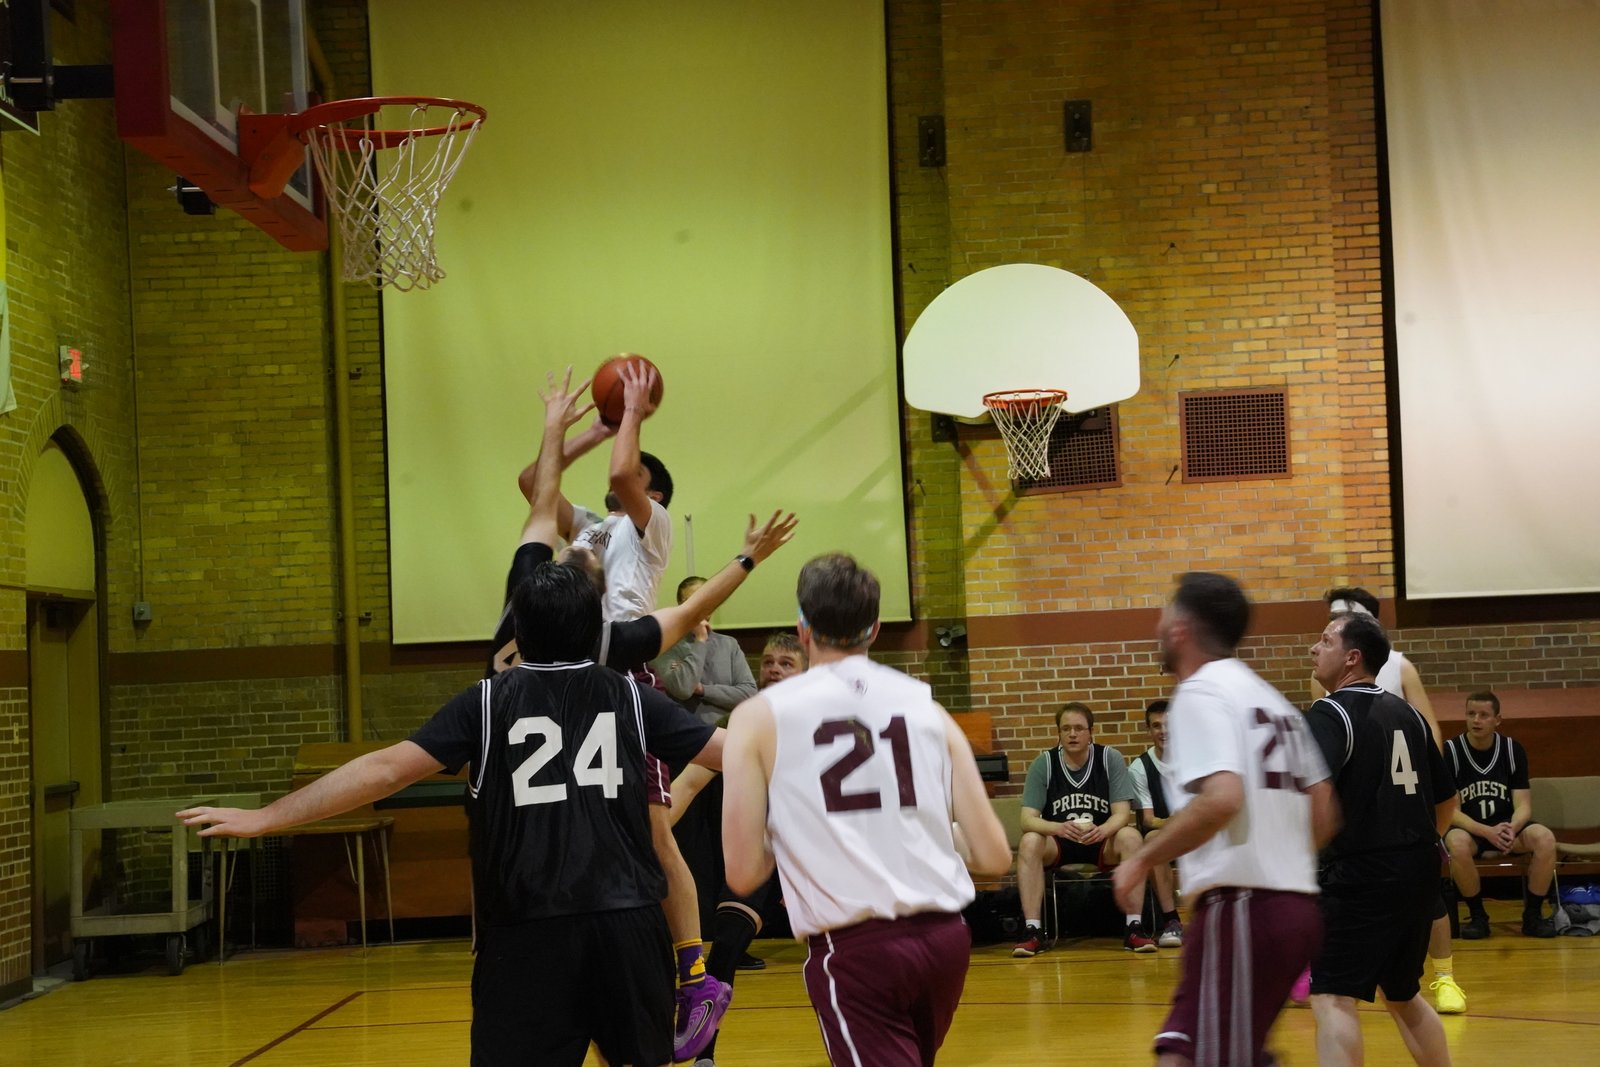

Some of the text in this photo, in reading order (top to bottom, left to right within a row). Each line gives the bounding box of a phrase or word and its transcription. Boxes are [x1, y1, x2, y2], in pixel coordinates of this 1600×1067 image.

[508, 711, 624, 808] 24
[813, 714, 918, 813] 21
[1390, 729, 1419, 795] 4
[1459, 780, 1510, 804] PRIEST
[1052, 793, 1109, 816] PRIESTS
